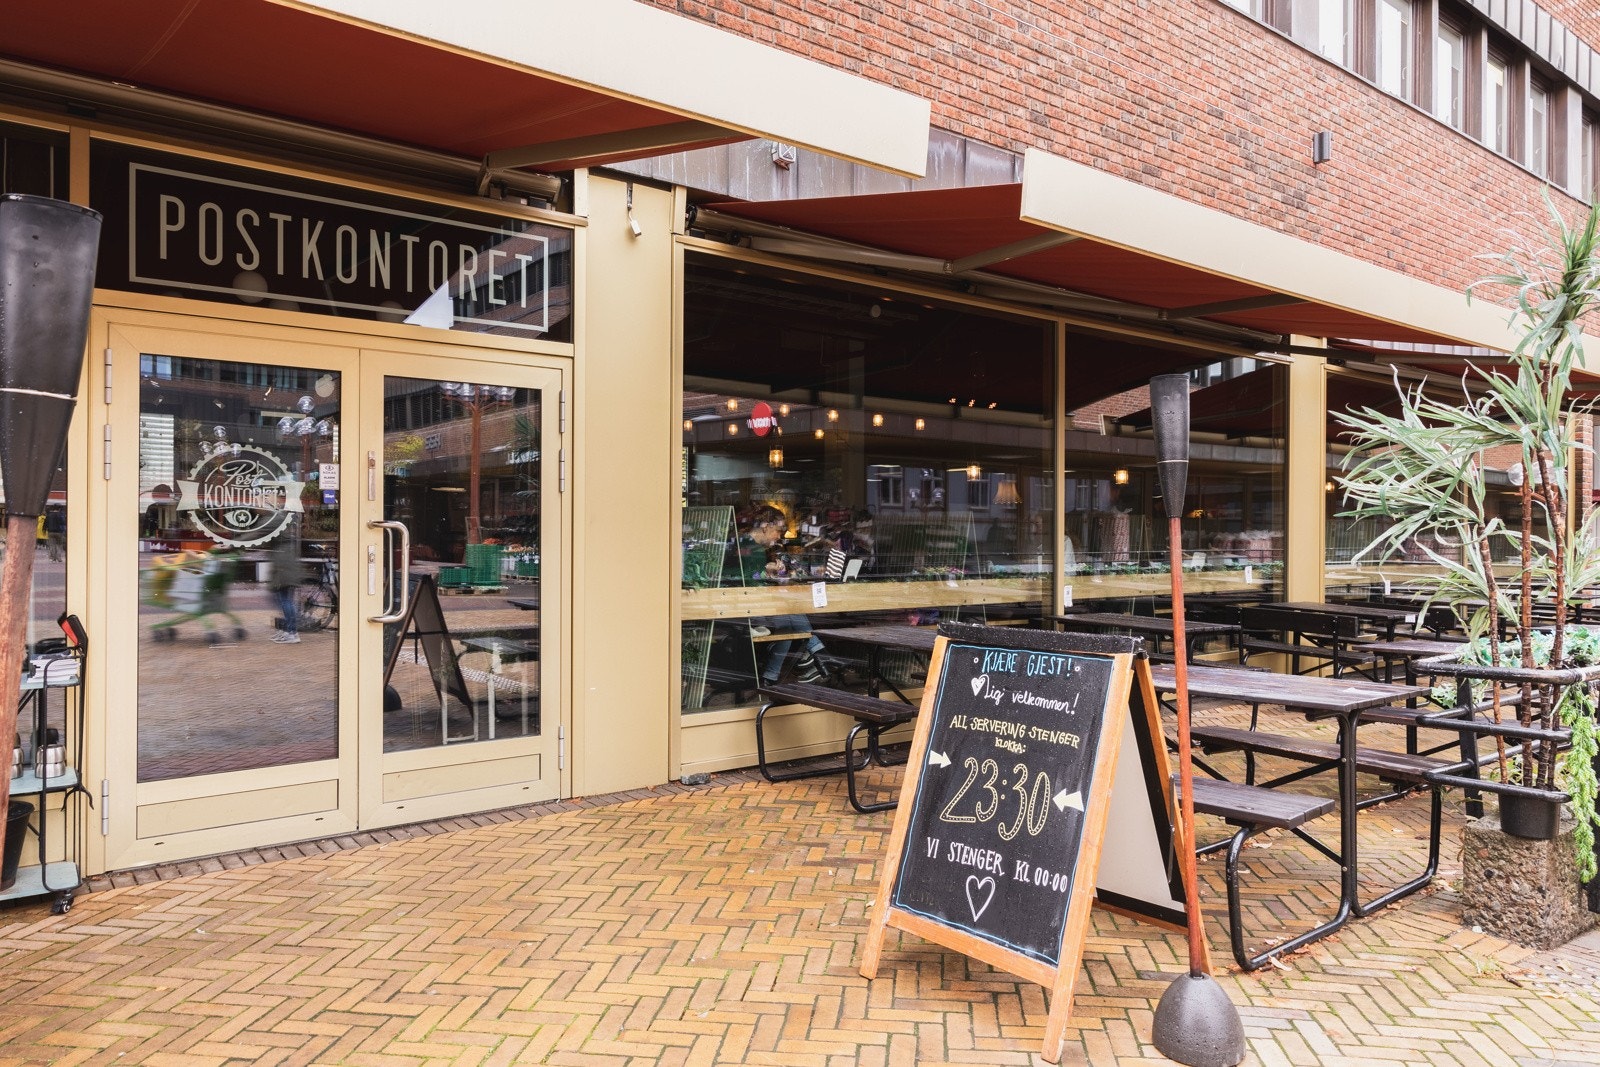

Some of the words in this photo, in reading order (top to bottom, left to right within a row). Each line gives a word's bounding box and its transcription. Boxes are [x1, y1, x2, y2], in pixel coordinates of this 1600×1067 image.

[159, 194, 533, 309] POSTKONTORET
[219, 459, 268, 486] Post
[204, 483, 280, 509] KONTORET
[981, 650, 1018, 674] KJÆRE
[1026, 655, 1072, 677] GJEST!
[1012, 690, 1080, 715] velkommen!
[949, 715, 968, 730] ALL
[970, 717, 1026, 739] SERVERING
[1028, 726, 1081, 749] STENGER
[995, 737, 1027, 754] KLOKKA:
[939, 757, 1051, 841] 23:30
[927, 837, 940, 859] VI
[947, 841, 1005, 876] STENGER
[1034, 867, 1068, 893] 00:00
